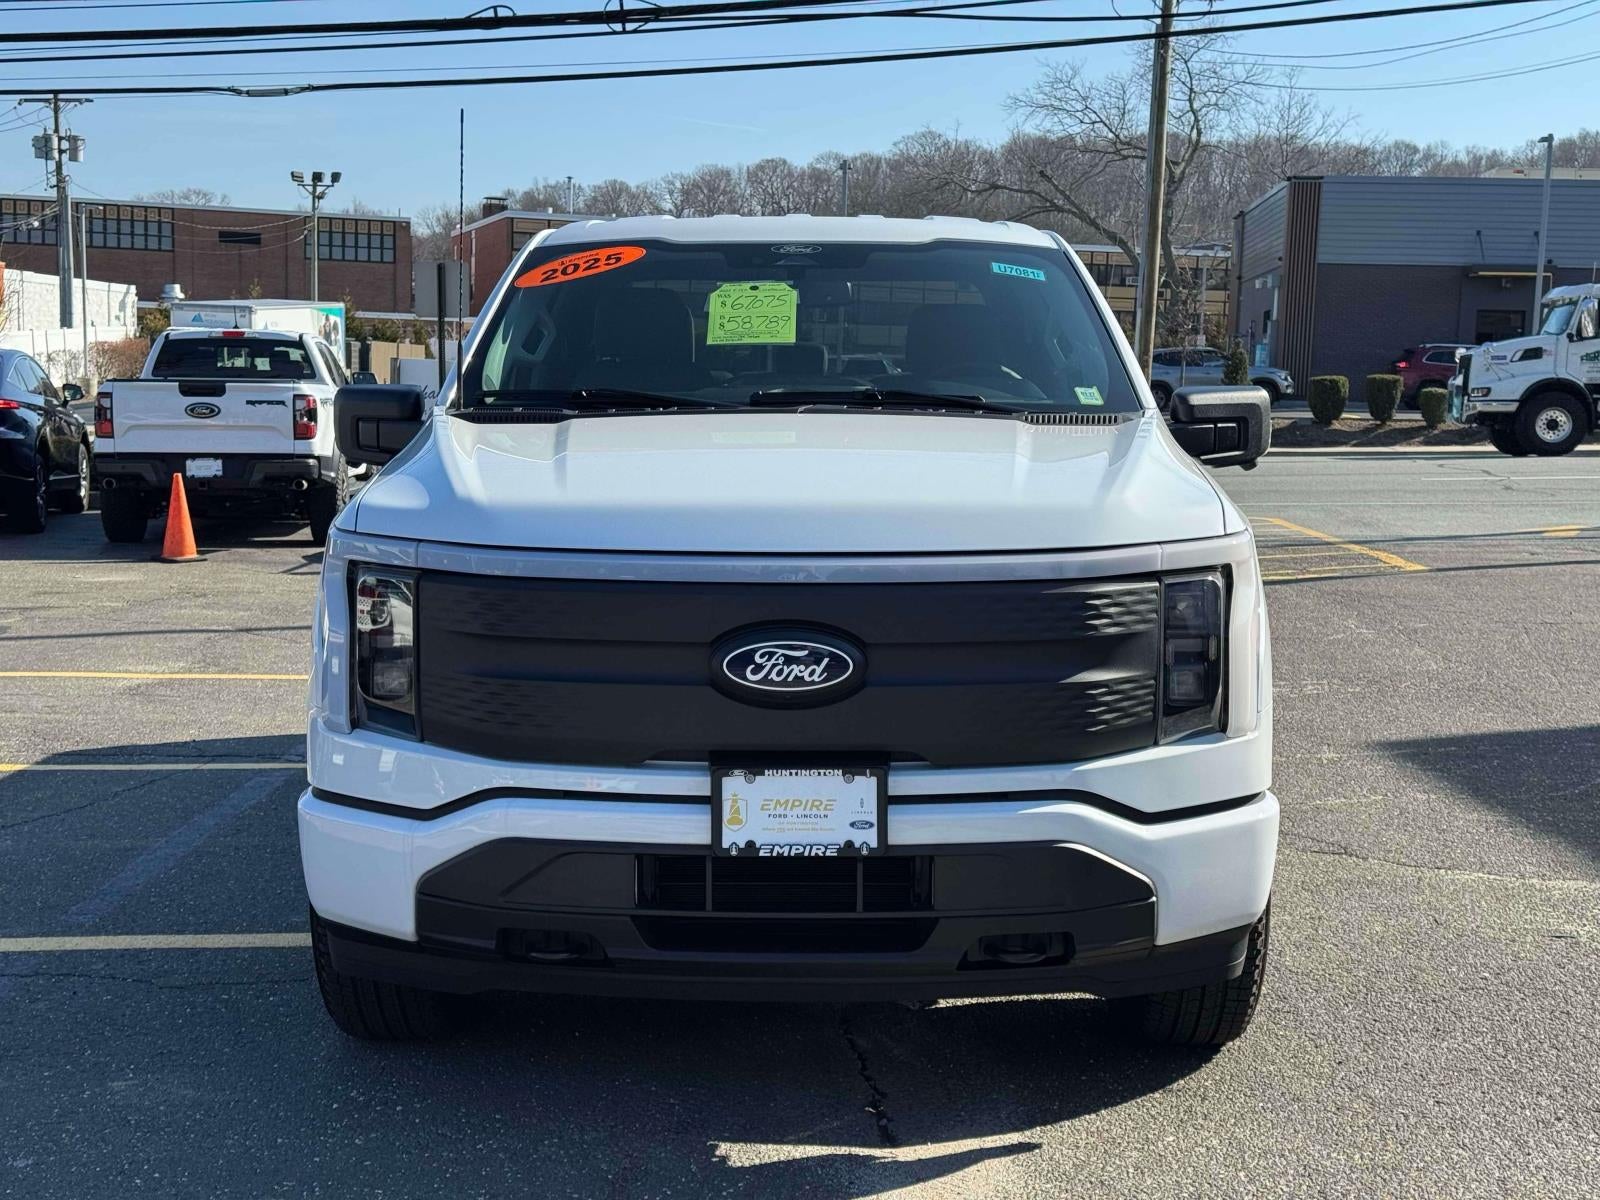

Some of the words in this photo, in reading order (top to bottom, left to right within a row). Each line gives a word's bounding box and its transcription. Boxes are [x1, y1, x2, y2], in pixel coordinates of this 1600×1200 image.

[540, 252, 625, 283] 2025
[746, 648, 830, 682] Ford
[764, 769, 842, 777] HUNTINGTON
[760, 799, 837, 811] EMPIRE
[759, 845, 839, 857] EMPIRE
